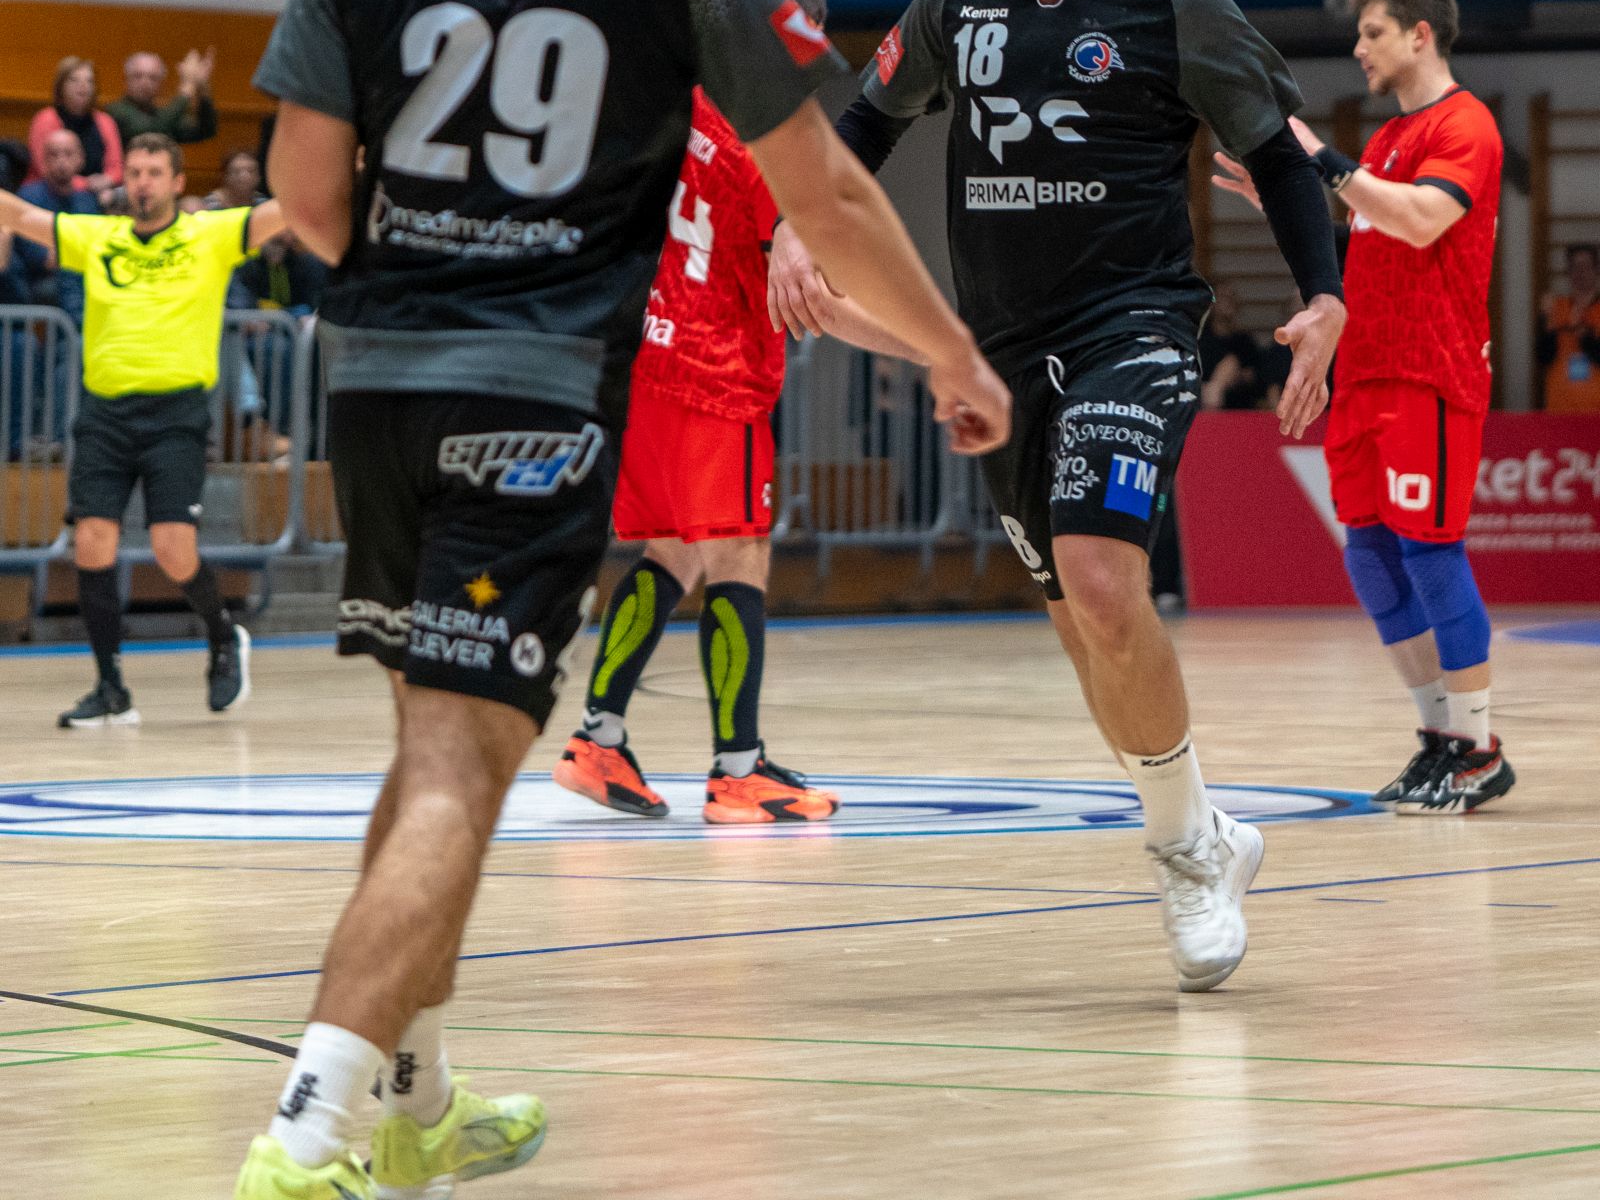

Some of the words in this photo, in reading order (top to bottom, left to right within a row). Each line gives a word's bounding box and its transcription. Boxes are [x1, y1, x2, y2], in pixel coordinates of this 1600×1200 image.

[960, 5, 1009, 21] Kempa
[954, 22, 1009, 88] 18
[381, 1, 610, 199] 29
[1112, 453, 1159, 497] TM
[1386, 467, 1431, 511] 10
